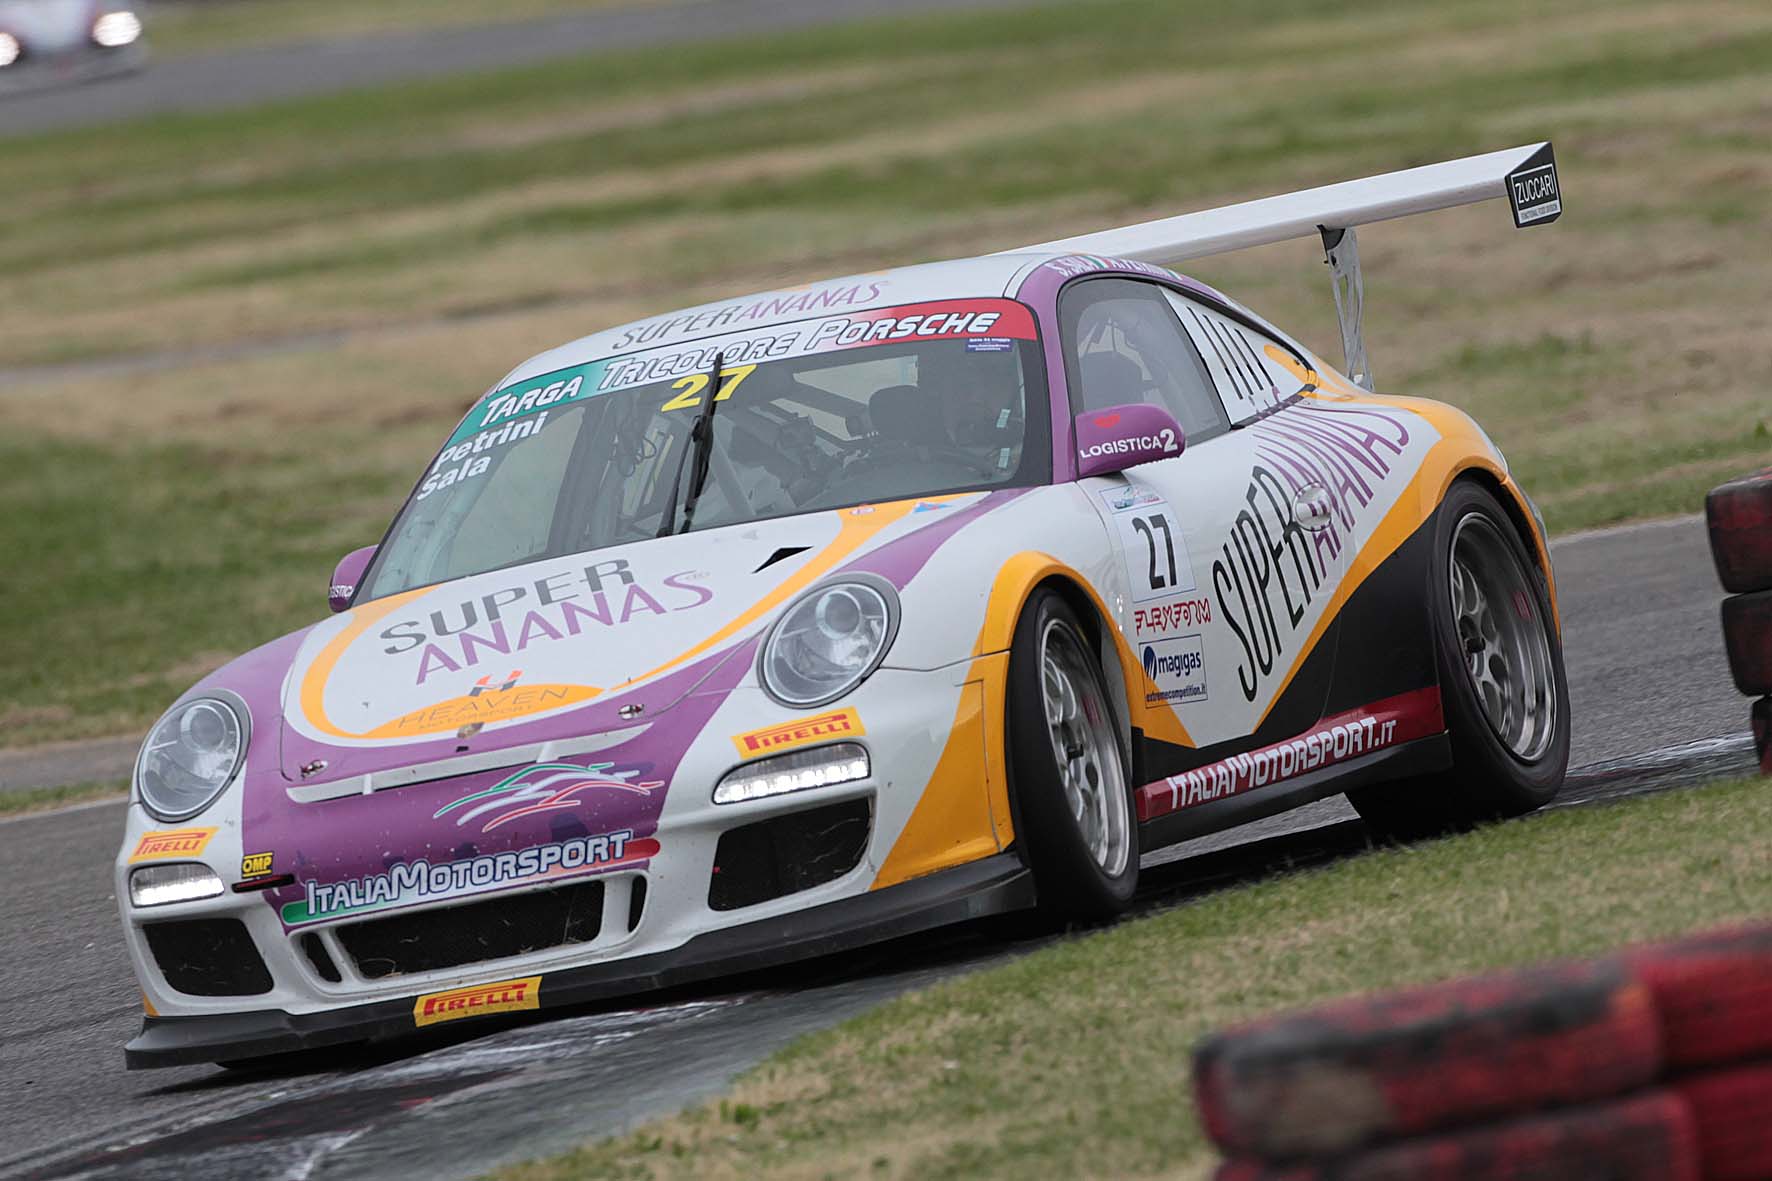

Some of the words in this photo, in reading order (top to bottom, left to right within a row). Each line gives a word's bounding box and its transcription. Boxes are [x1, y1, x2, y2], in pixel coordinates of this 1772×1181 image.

[1515, 173, 1555, 204] ZUCCARI
[613, 281, 891, 349] SUPERANANAS
[479, 375, 584, 427] TARGA
[597, 332, 800, 391] TRICOLORE
[806, 311, 1001, 351] PORSCHE
[661, 364, 758, 412] 27
[1132, 513, 1177, 590] 27
[380, 559, 635, 655] SUPER
[416, 570, 713, 685] ANANAS
[1157, 650, 1201, 677] magigas
[398, 688, 568, 728] HEAVEN
[744, 714, 851, 750] PIRELLI
[135, 832, 207, 856] PIRELLI
[242, 856, 273, 874] OMP
[424, 982, 528, 1017] PIRELLI
